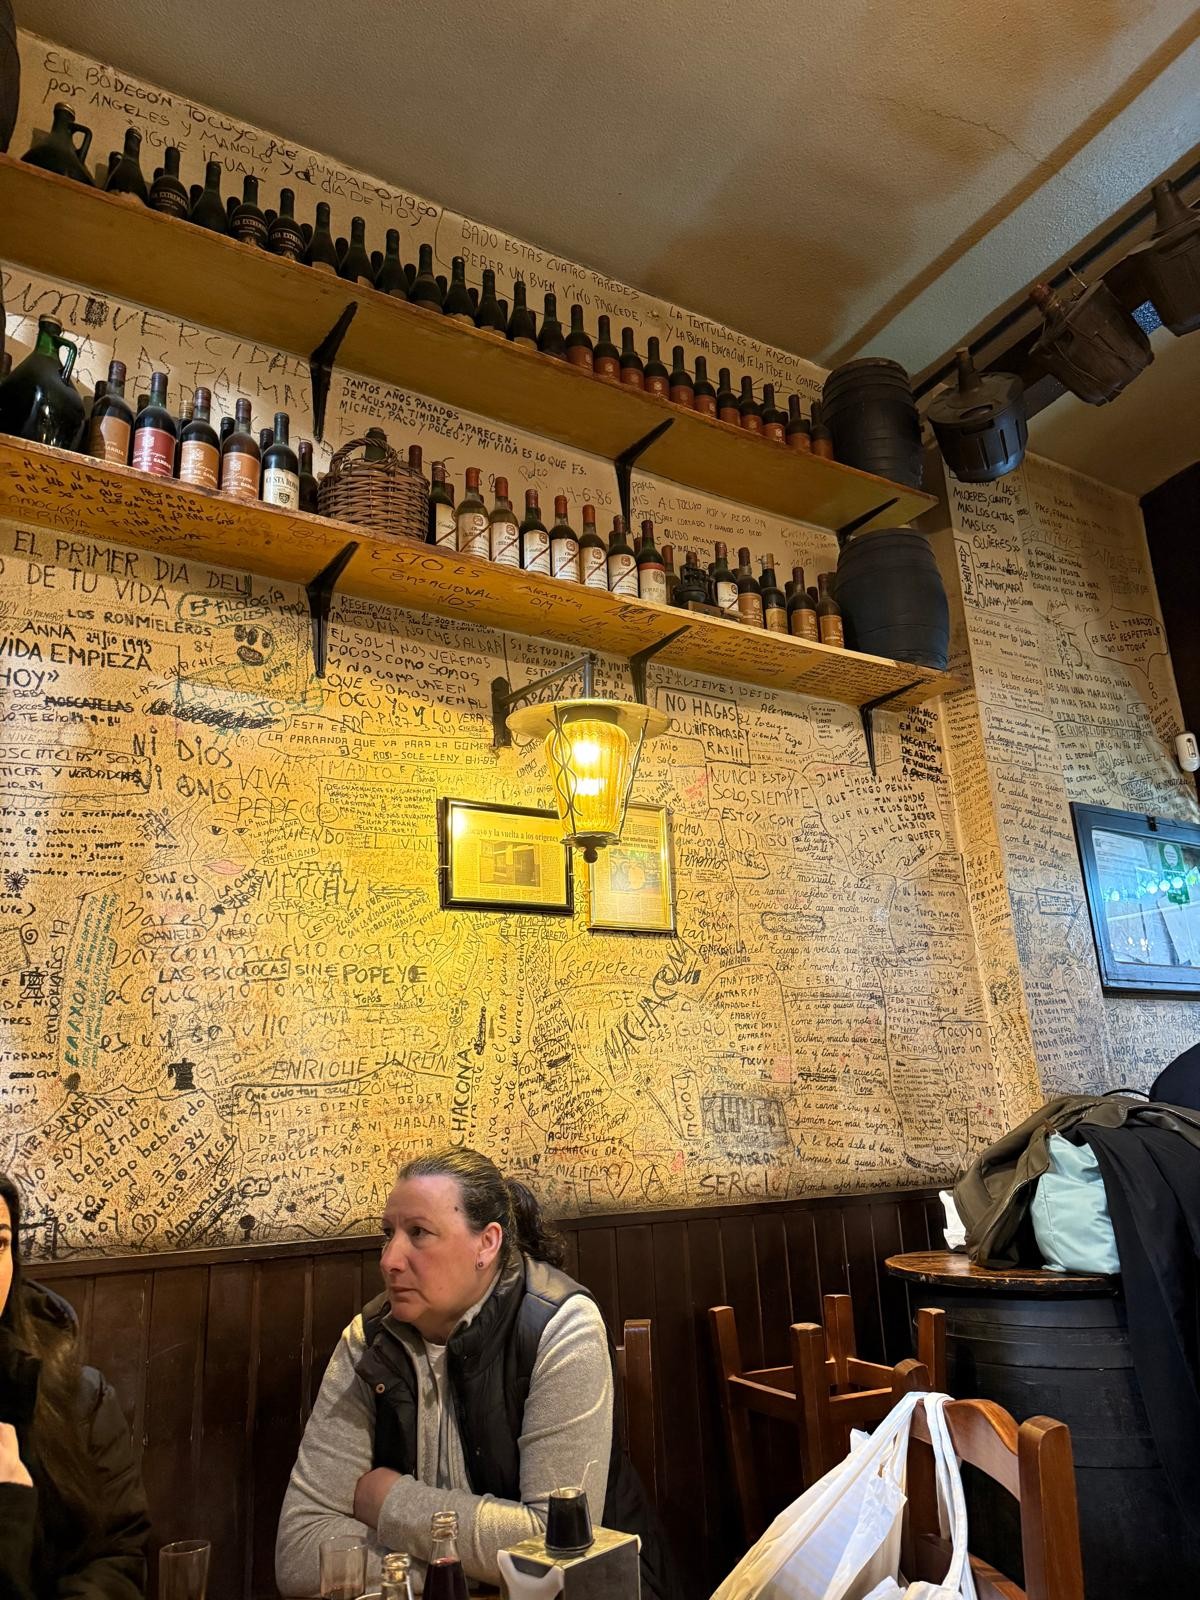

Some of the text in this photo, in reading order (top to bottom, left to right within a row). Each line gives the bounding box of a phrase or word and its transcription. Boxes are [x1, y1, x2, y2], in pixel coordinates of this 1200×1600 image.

[342, 387, 357, 400] DE
[360, 393, 404, 415] ACUSADA
[344, 377, 381, 395] TANTOS
[384, 388, 412, 407] AÑOS
[14, 530, 42, 557] EL
[55, 538, 139, 579] PRIMER
[27, 562, 171, 611] DE TU VIDA
[50, 643, 153, 673] EMPIEZA
[666, 693, 738, 722] NO HAGAS
